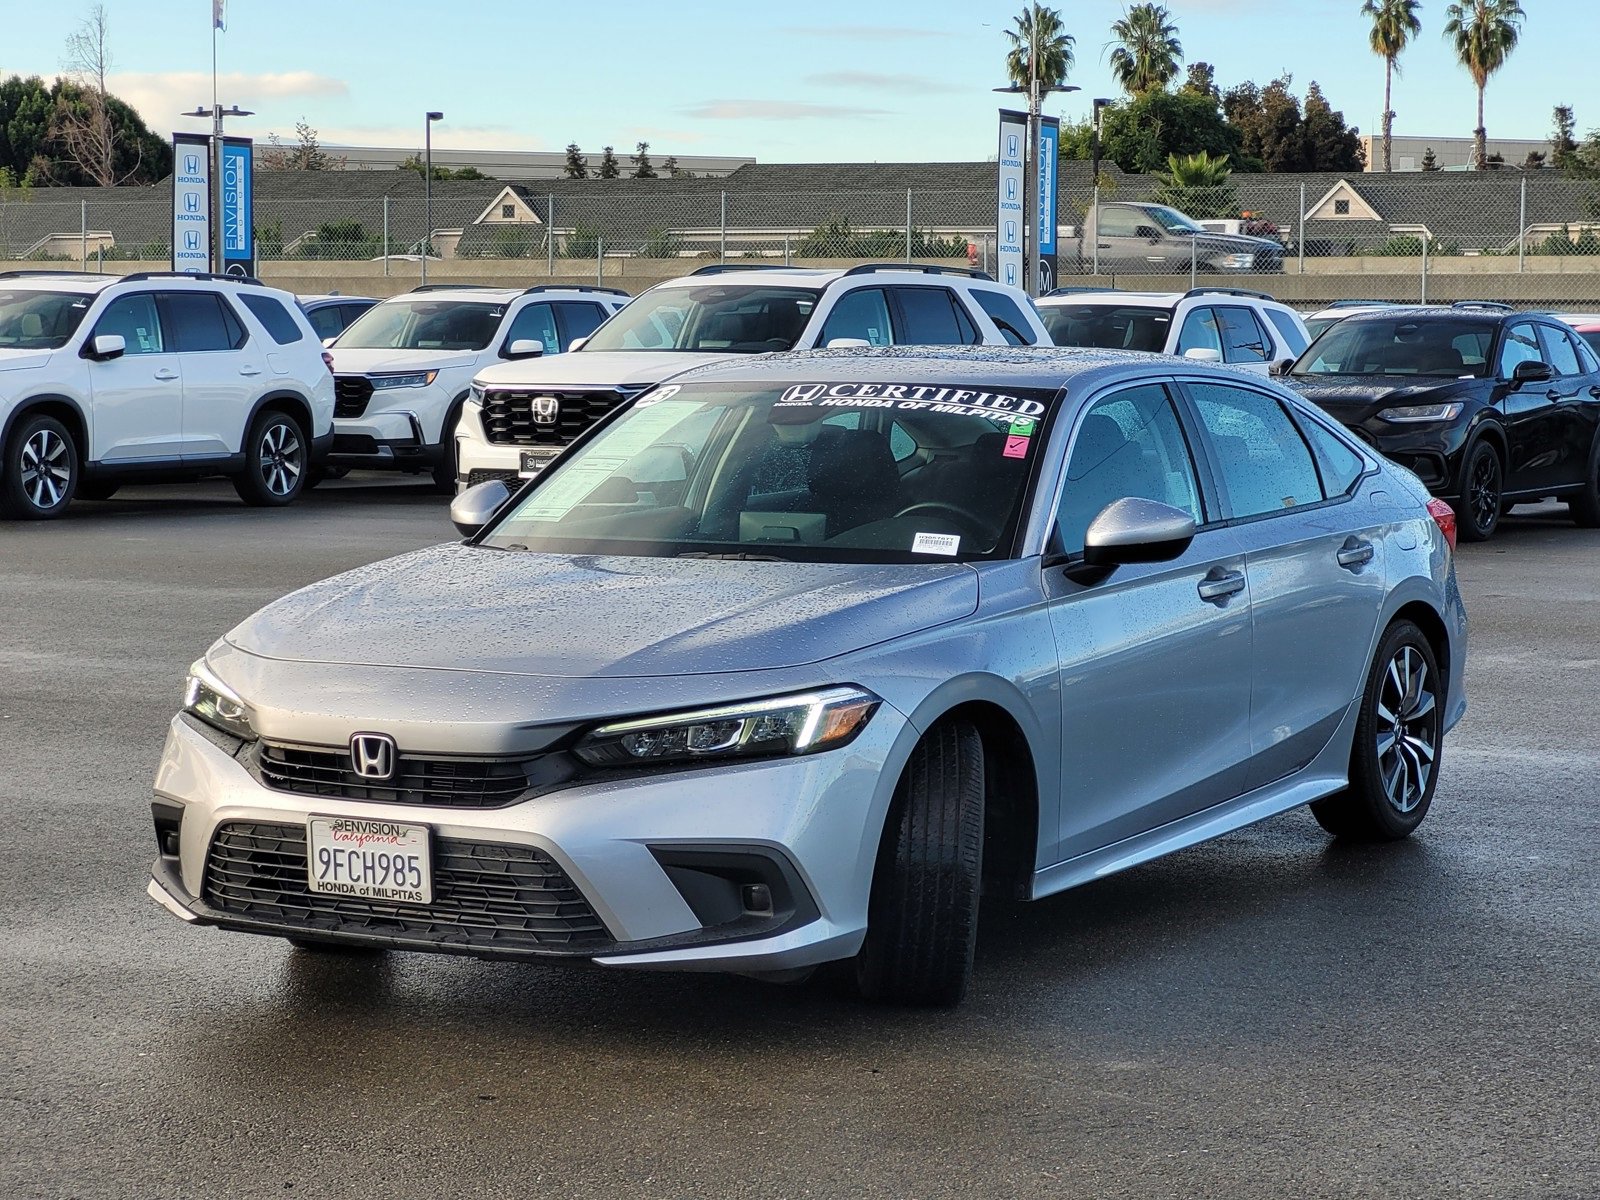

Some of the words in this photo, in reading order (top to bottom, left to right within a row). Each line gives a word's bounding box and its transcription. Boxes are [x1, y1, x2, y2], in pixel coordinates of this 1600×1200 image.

[1001, 159, 1022, 168] HONDA
[177, 176, 206, 184] HONDA
[225, 155, 237, 250] ENVISION
[1001, 201, 1021, 210] HONDA
[177, 214, 206, 222] HONDA
[1000, 245, 1021, 253] HONDA
[829, 384, 1045, 416] CERTIFIED
[819, 398, 894, 408] HONDA
[898, 401, 931, 410] OF
[929, 403, 1032, 425] MILPITAS
[345, 820, 400, 836] ENVISION
[333, 830, 407, 848] California
[318, 847, 421, 889] 9FCH985
[317, 881, 356, 894] HONDA
[360, 886, 370, 895] of
[373, 887, 422, 901] MILPITAS
